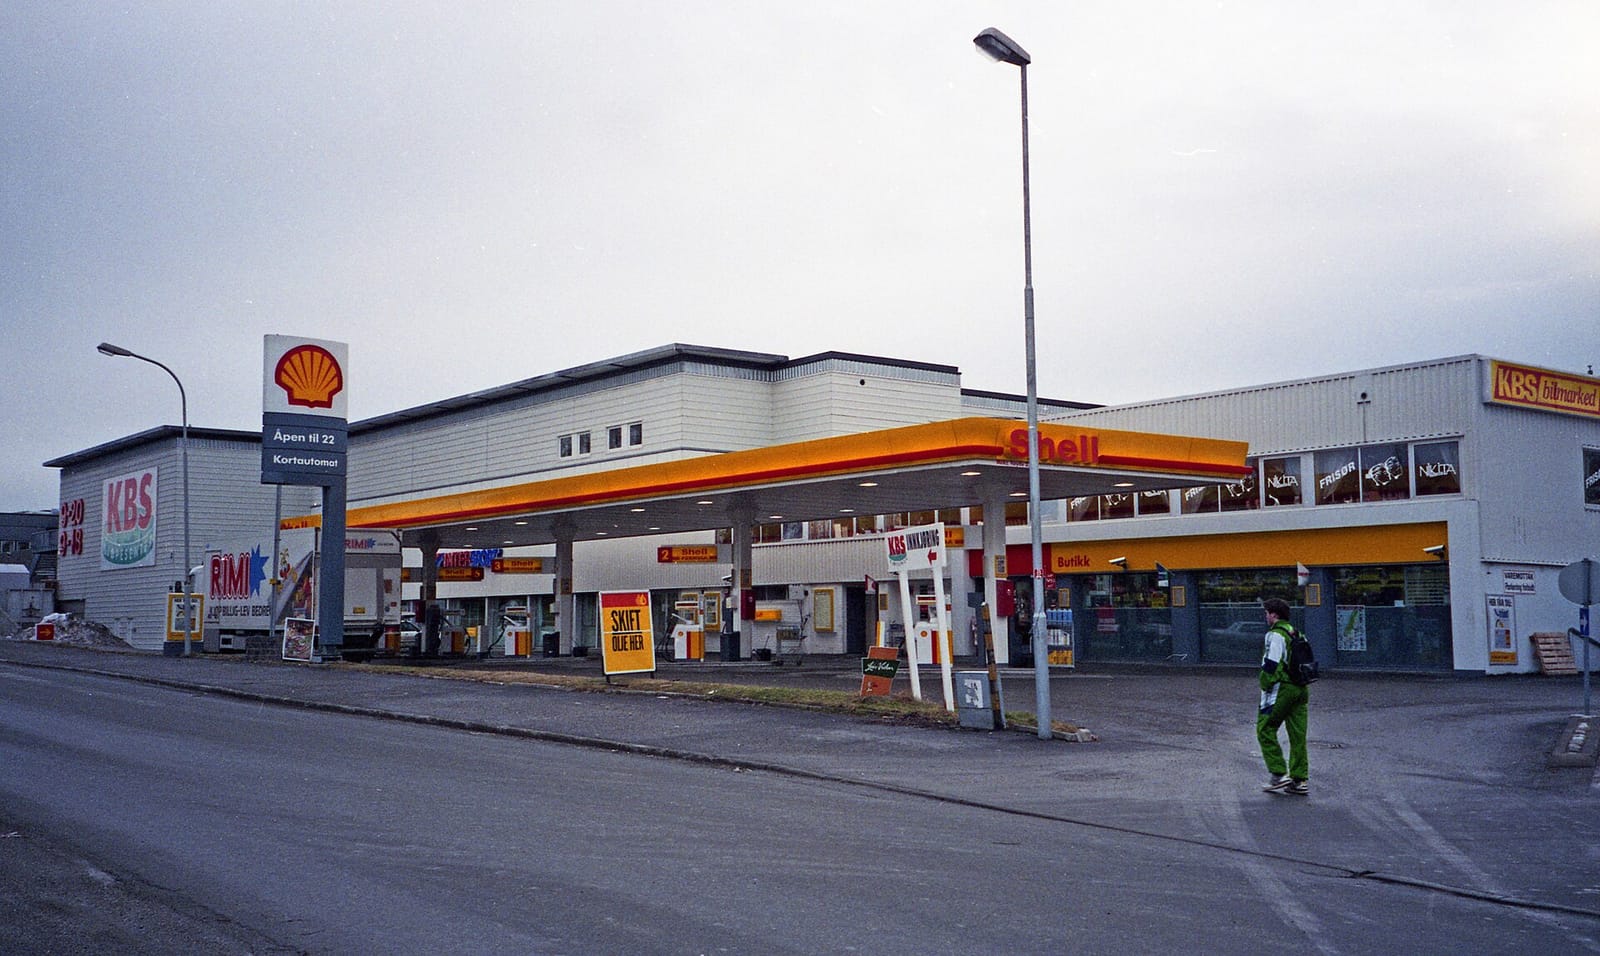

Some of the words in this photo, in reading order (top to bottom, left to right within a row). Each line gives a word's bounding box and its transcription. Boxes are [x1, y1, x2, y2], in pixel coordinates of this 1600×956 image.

[1498, 368, 1537, 402] KBS
[1543, 380, 1596, 407] bilmarked
[273, 428, 305, 443] Åpen
[309, 433, 319, 443] til
[322, 434, 335, 445] 22
[1010, 428, 1098, 464] Shell
[273, 455, 338, 467] Kortautomat
[1585, 469, 1600, 489] FRIS
[61, 498, 84, 528] 9-20
[107, 473, 153, 534] KBS
[60, 528, 83, 557] 9-18
[888, 535, 906, 556] KBS
[1057, 555, 1090, 568] Butikk
[210, 552, 250, 600] RIMI
[611, 609, 641, 632] SKIFT
[612, 635, 629, 652] OLJE
[629, 635, 644, 651] HER
